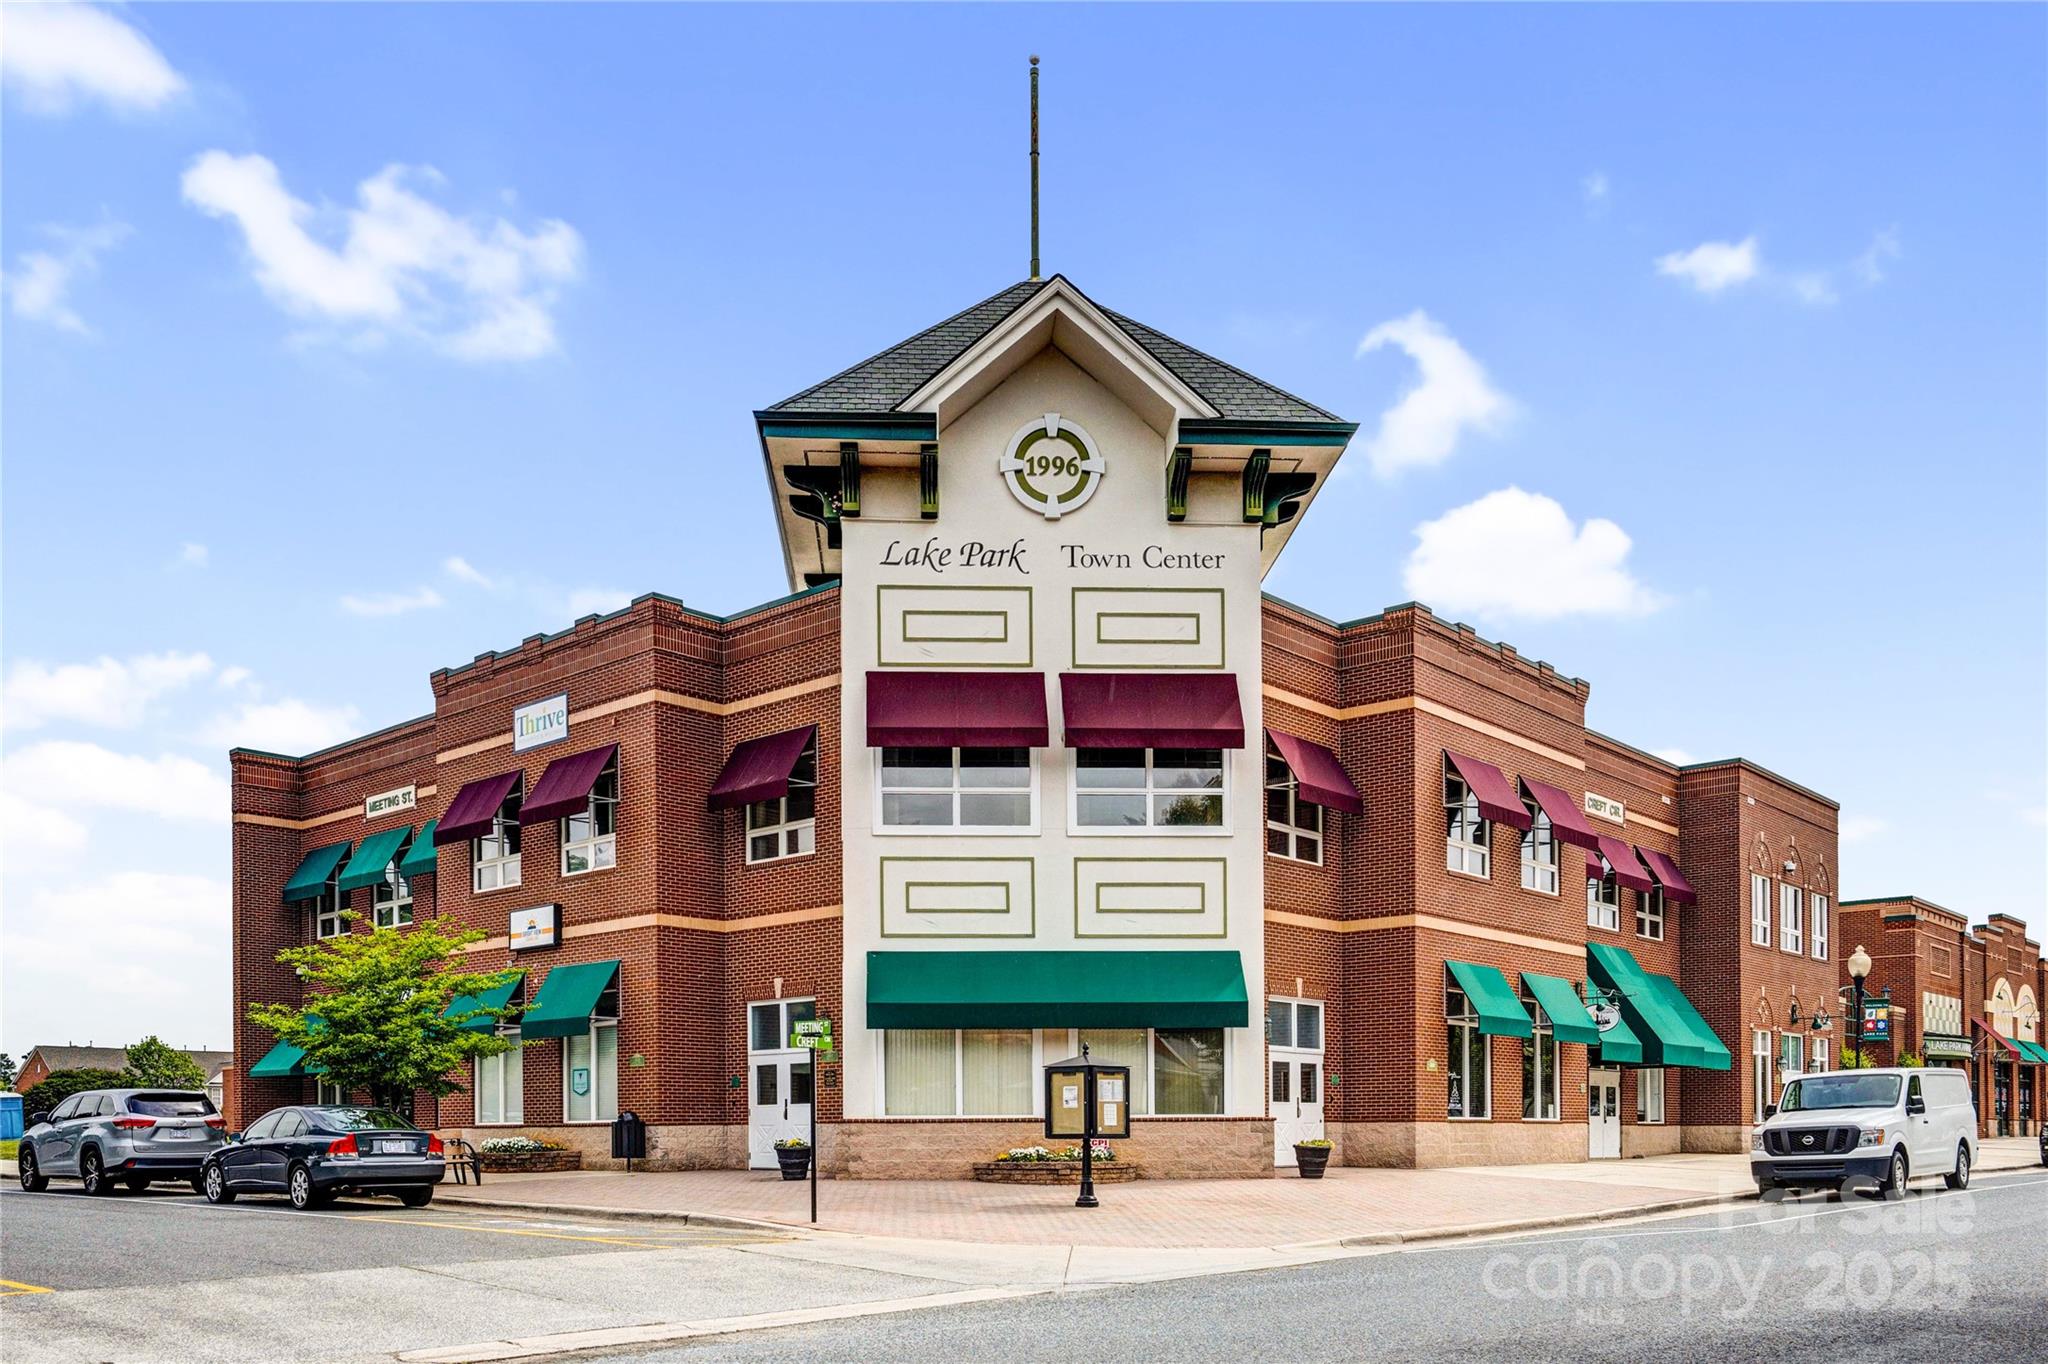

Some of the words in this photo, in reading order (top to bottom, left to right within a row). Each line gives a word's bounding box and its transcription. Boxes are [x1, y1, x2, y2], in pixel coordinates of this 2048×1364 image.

[1026, 455, 1080, 477] 1996
[879, 536, 951, 573] Lake
[959, 538, 1030, 574] Park
[1060, 545, 1132, 569] Town
[1142, 545, 1226, 569] Center
[516, 705, 565, 738] Thrive
[368, 794, 400, 813] MEETING
[401, 791, 413, 805] ST.
[795, 1021, 824, 1034] MEETING
[796, 1035, 818, 1048] CREFT
[1931, 1040, 1950, 1050] LAKE
[1091, 1139, 1108, 1147] CPI
